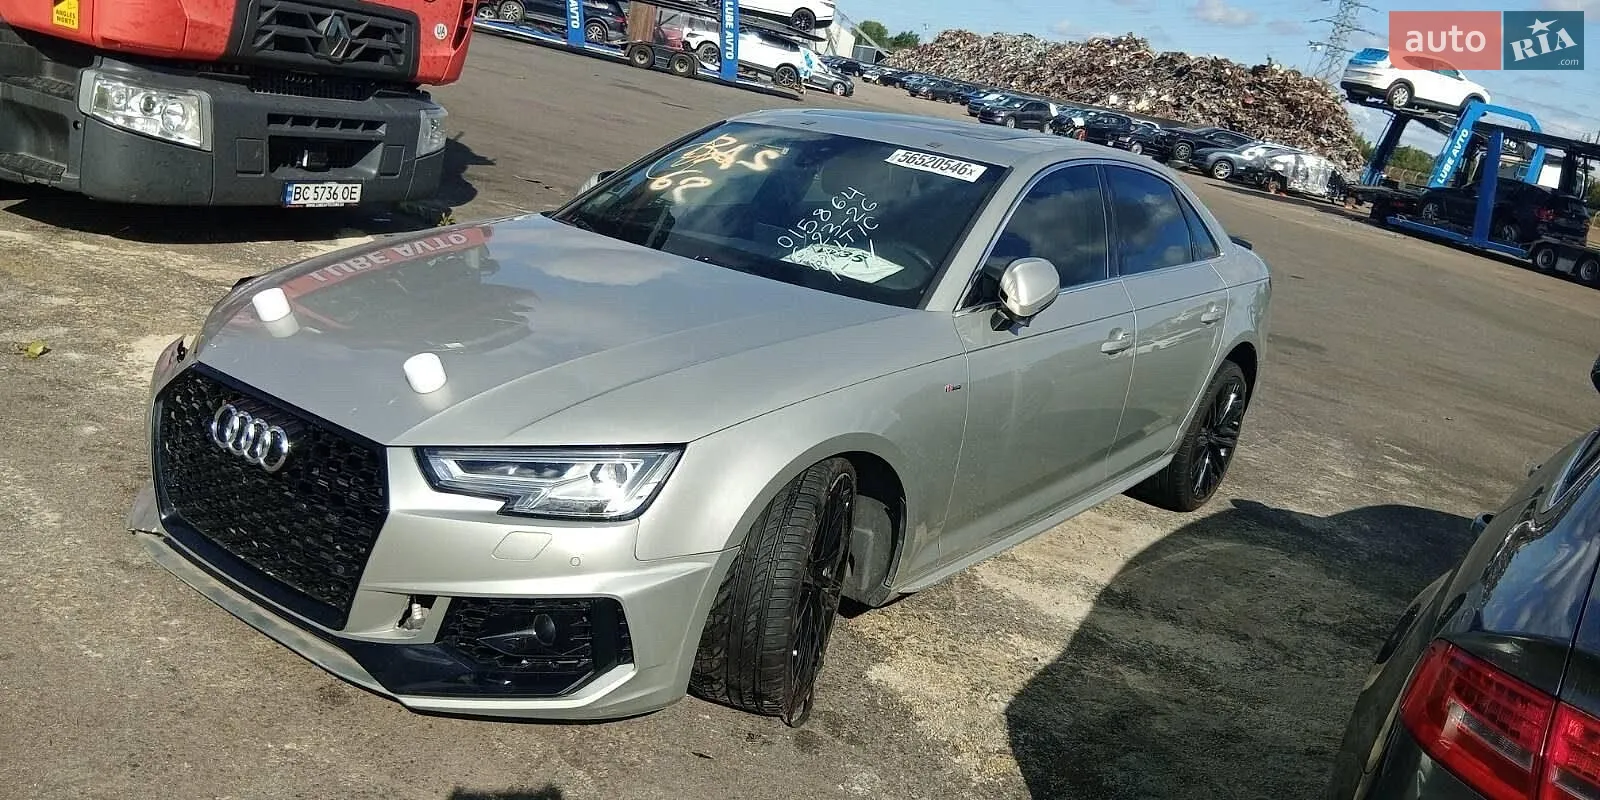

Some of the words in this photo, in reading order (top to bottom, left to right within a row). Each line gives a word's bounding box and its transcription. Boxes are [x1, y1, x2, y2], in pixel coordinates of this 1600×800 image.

[725, 1, 734, 29] LUBE
[725, 30, 735, 60] AVTO
[1437, 157, 1455, 185] LUBE
[1451, 128, 1469, 158] AVTO
[293, 186, 311, 201] BC
[313, 186, 339, 201] 5736
[341, 186, 359, 201] OE
